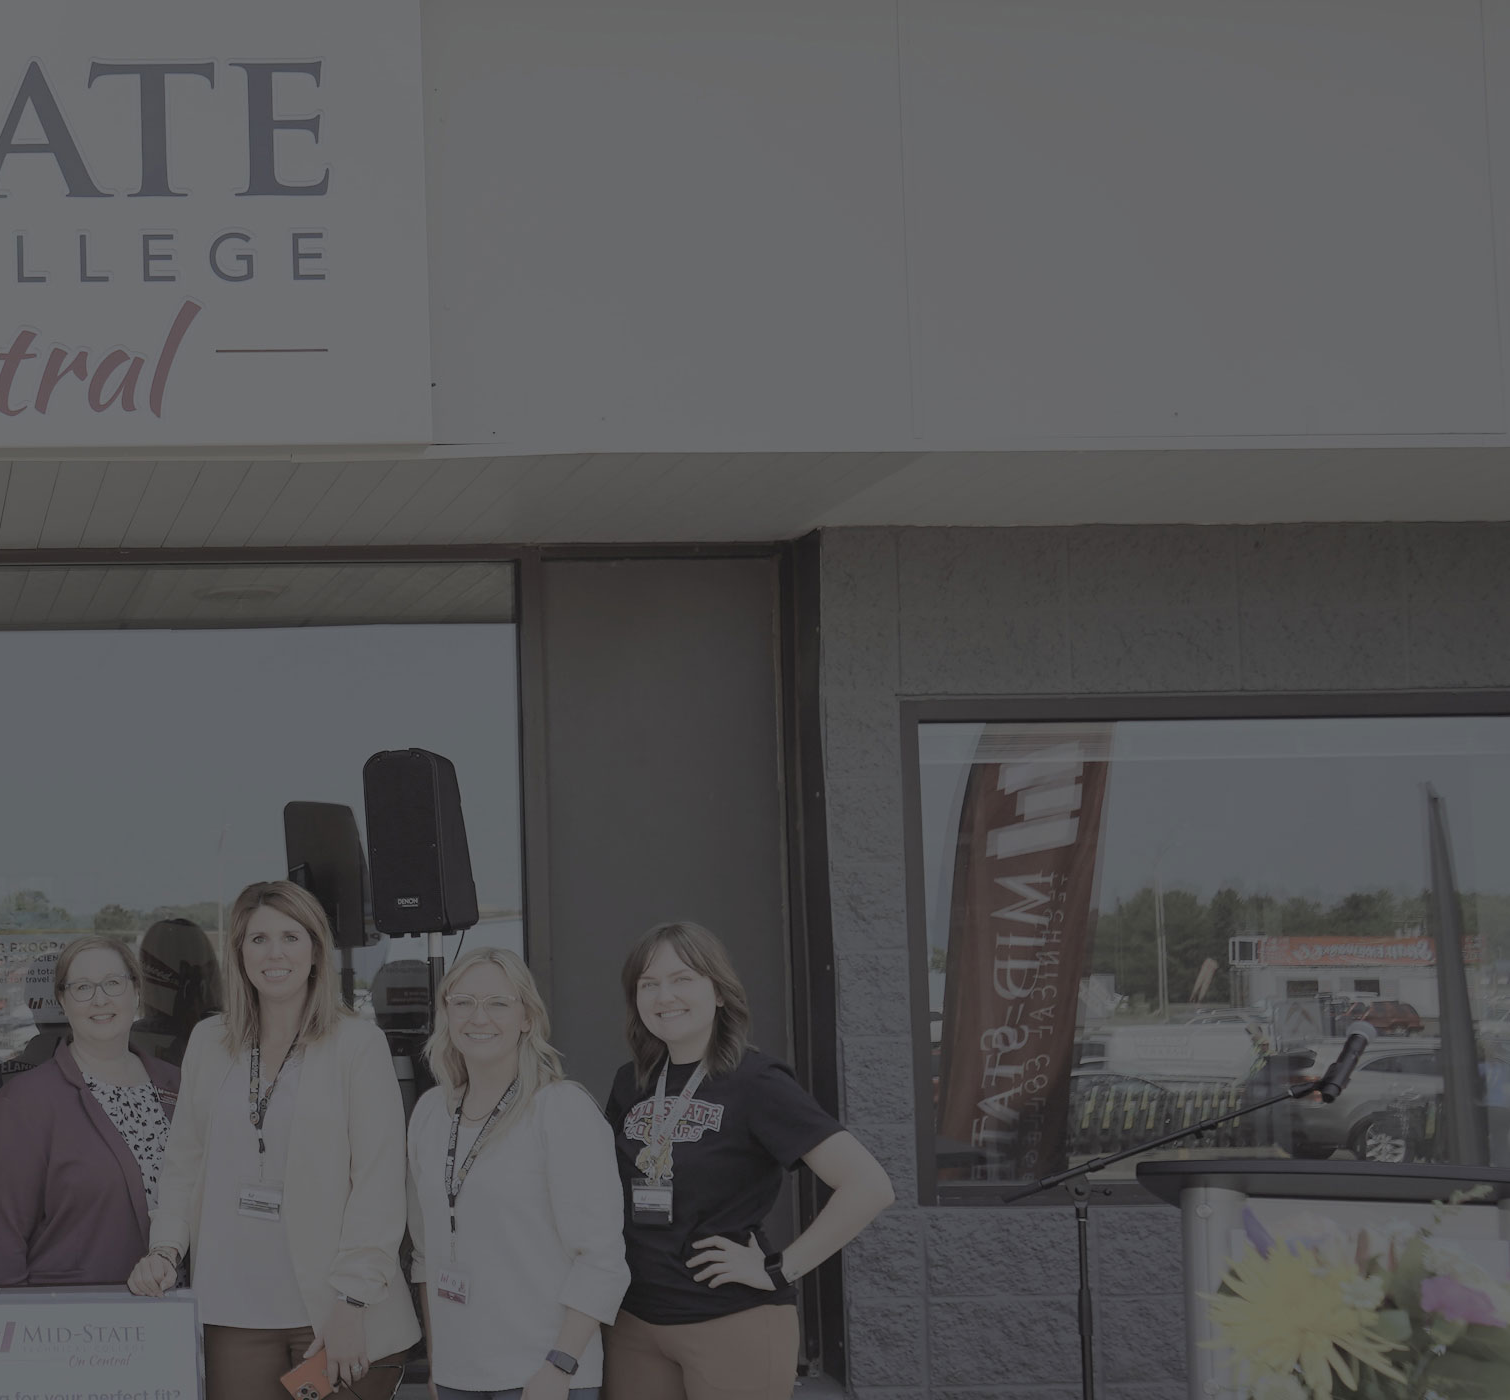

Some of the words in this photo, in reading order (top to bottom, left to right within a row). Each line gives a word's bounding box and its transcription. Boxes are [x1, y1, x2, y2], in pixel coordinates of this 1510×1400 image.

[397, 894, 419, 905] DENON
[22, 1323, 147, 1345] MID-STATE
[68, 1353, 87, 1369] On
[90, 1353, 132, 1368] Central
